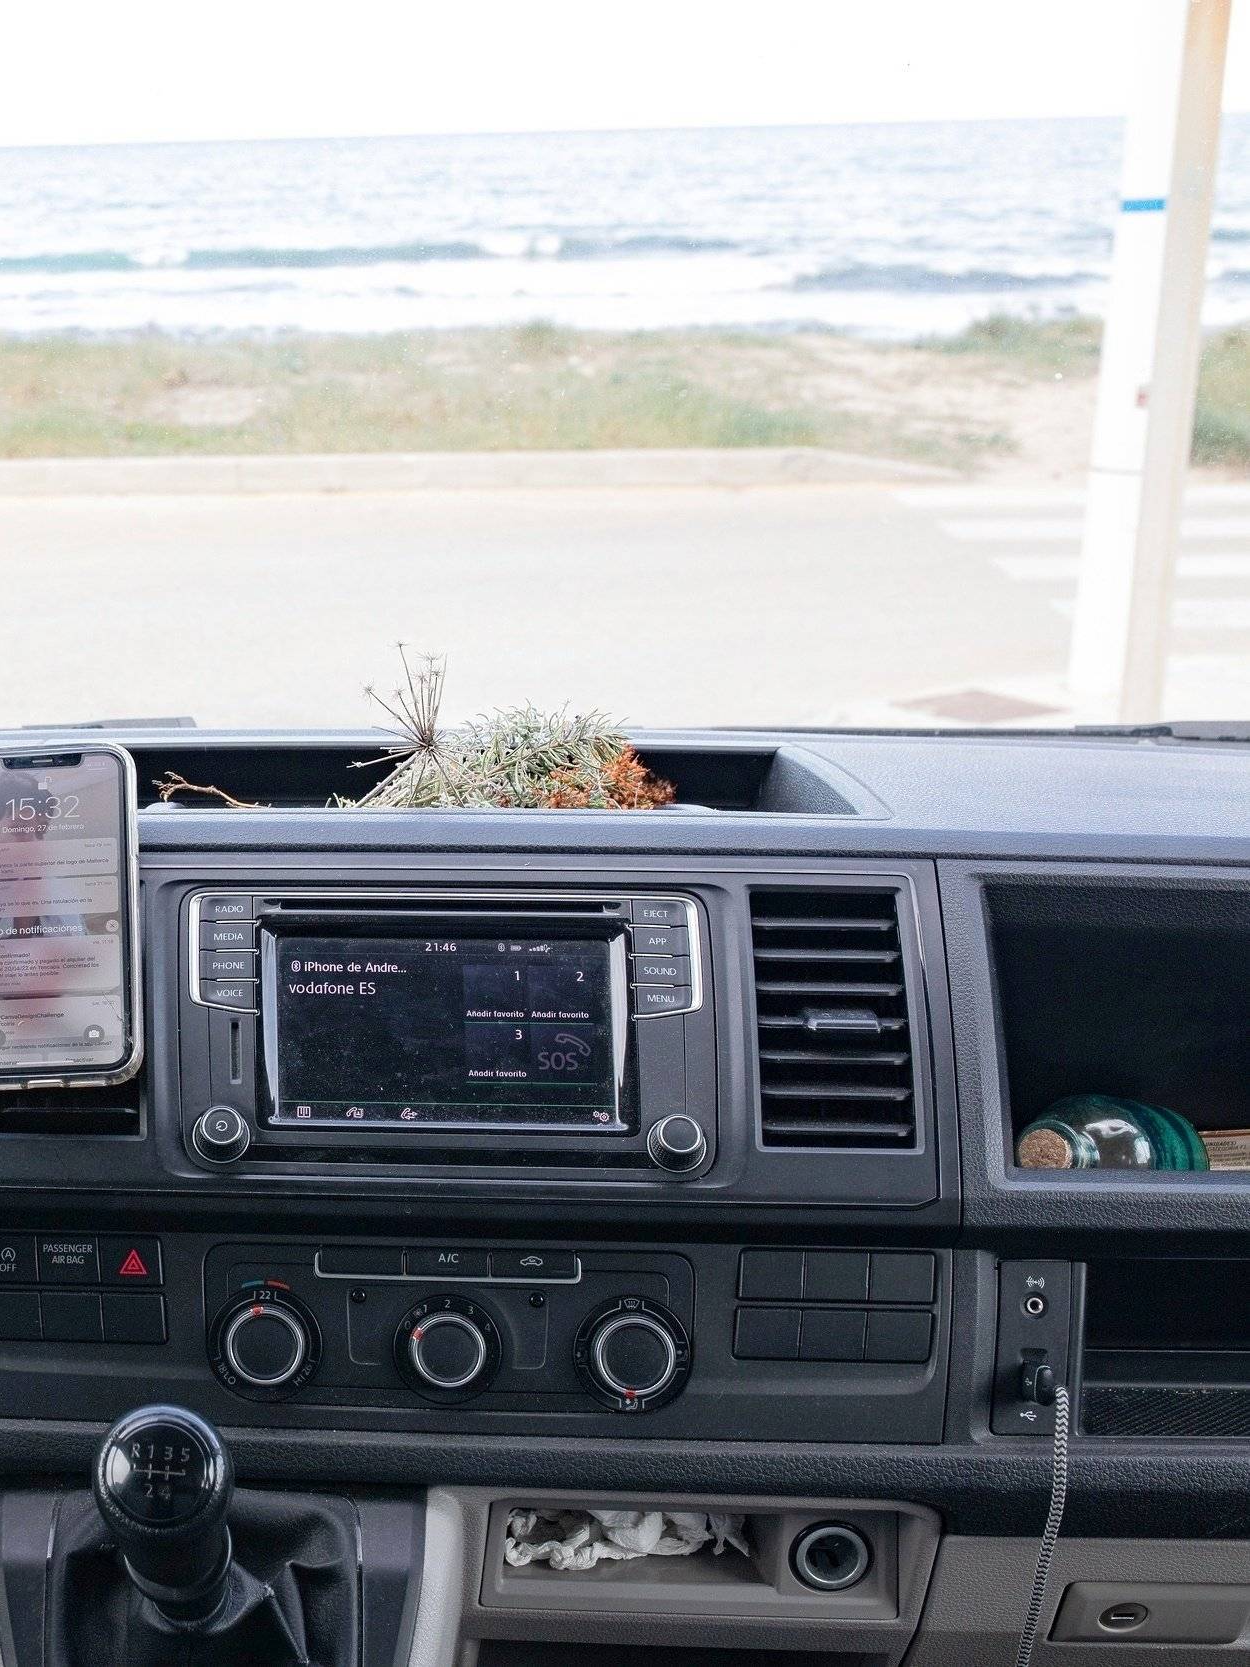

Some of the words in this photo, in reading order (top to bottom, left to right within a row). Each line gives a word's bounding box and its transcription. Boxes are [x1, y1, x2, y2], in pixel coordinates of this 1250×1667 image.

[5, 796, 80, 821] 15:32
[2, 826, 35, 834] Domingo,
[215, 905, 244, 913] RADIO
[644, 910, 668, 918] EJECT
[6, 927, 17, 935] de
[19, 925, 83, 934] notificaciones
[649, 937, 667, 945] APP
[425, 943, 457, 952] 21:46
[304, 961, 343, 972] iPhone
[347, 962, 361, 972] de
[365, 962, 407, 973] Andre...
[643, 967, 677, 975] SOUND
[515, 971, 520, 980] 1
[576, 972, 584, 981] 2
[289, 982, 354, 994] vodafone
[359, 982, 376, 994] ES
[216, 989, 244, 997] VOICE
[647, 994, 675, 1003] MENU
[493, 1010, 524, 1018] favorito
[531, 1010, 556, 1018] Añadir
[559, 1011, 589, 1019] favorito
[515, 1030, 522, 1039] 3
[537, 1051, 578, 1070] SOS
[468, 1069, 494, 1077] Añadir
[496, 1070, 527, 1078] favorito
[43, 1244, 93, 1253] PASSENGER
[438, 1253, 459, 1263] A/C
[0, 1264, 17, 1272] OFF
[259, 1291, 270, 1300] 22
[445, 1300, 450, 1308] 2
[469, 1306, 474, 1315] 3
[485, 1323, 491, 1331] 4
[131, 1443, 140, 1458] R
[148, 1444, 154, 1459] 1
[164, 1446, 173, 1460] 3
[181, 1448, 190, 1462] 5
[144, 1484, 153, 1497] 2
